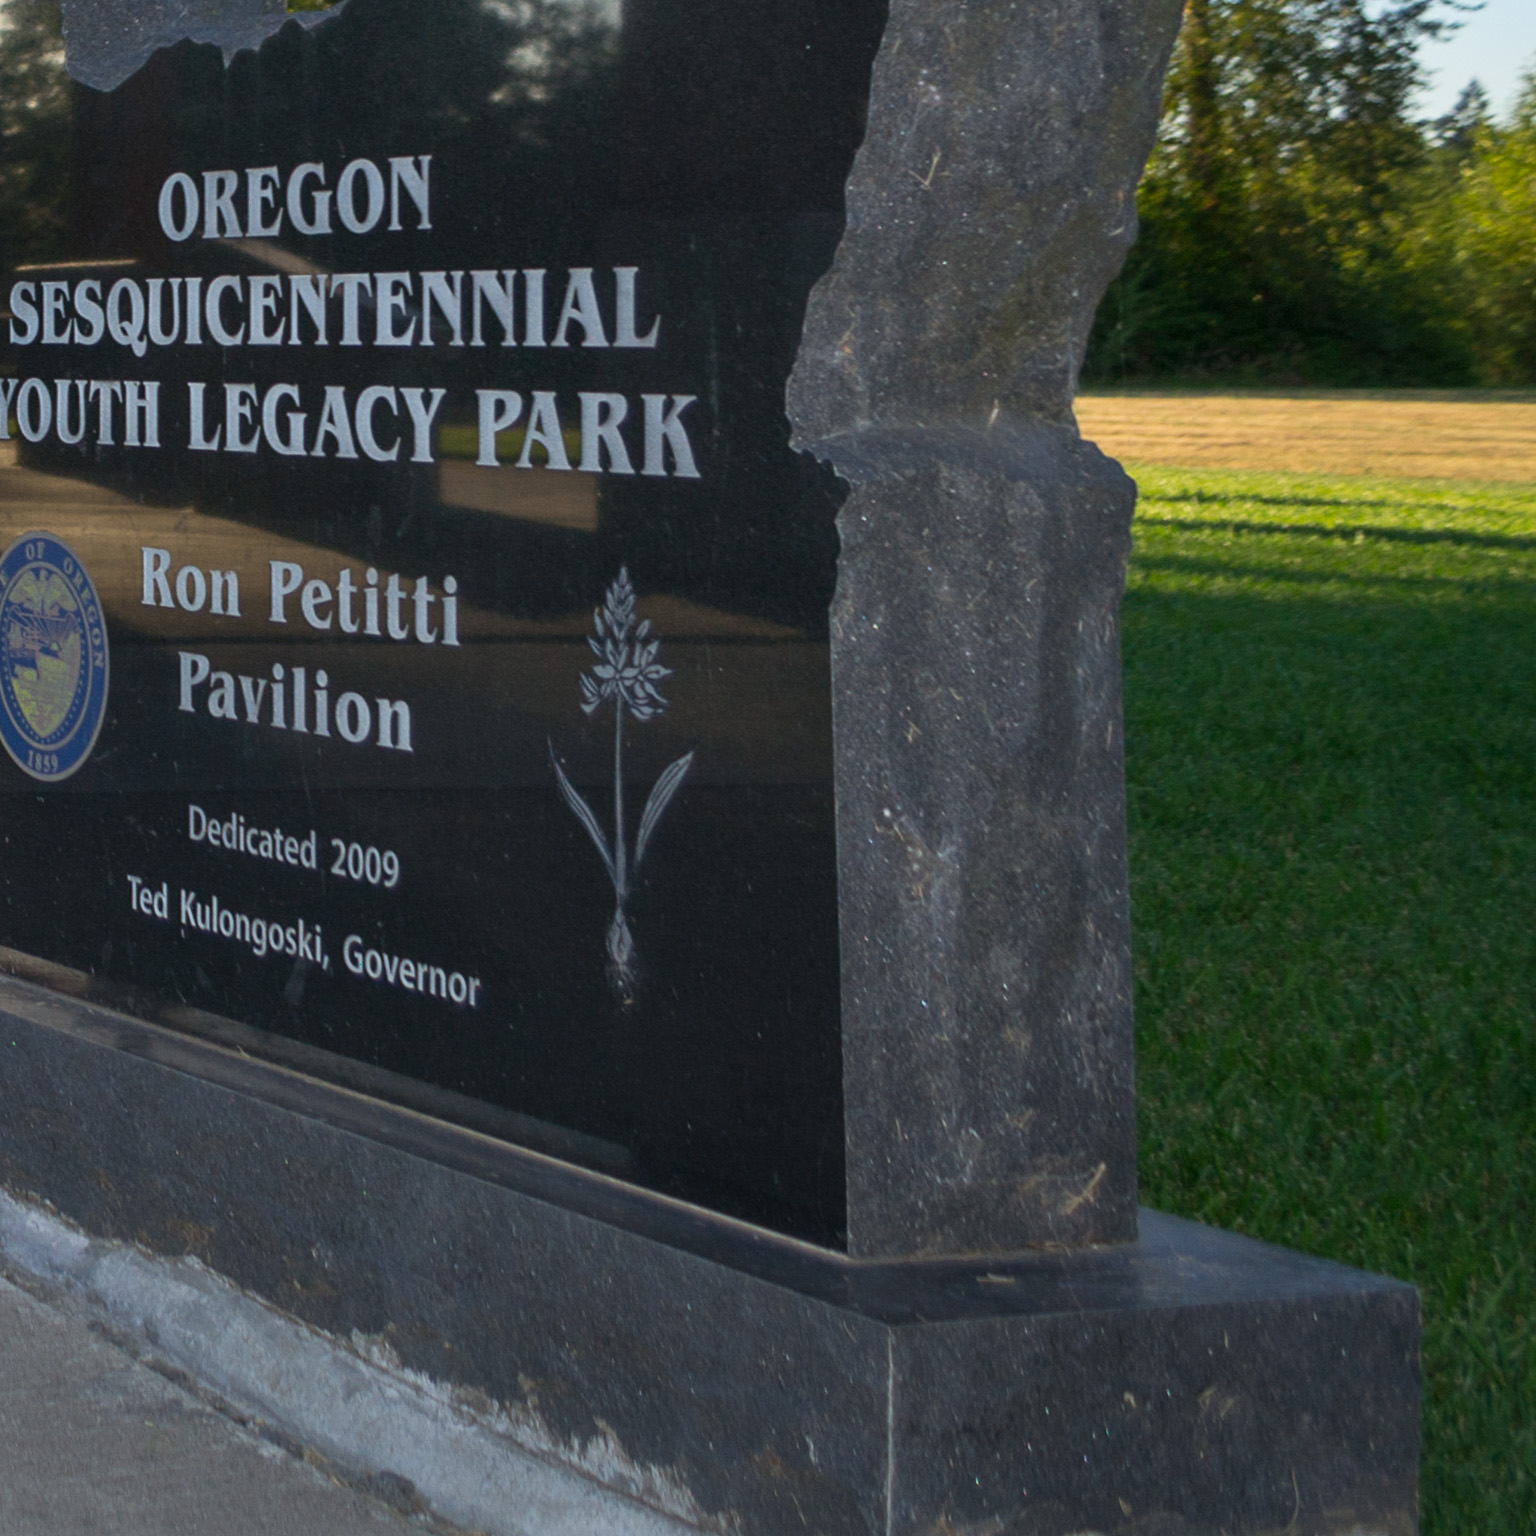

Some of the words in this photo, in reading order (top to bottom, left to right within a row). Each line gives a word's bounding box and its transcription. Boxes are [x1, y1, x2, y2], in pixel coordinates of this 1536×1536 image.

[158, 154, 433, 242] OREGON
[9, 267, 661, 358] SESQUICENTENNIAL
[187, 382, 447, 464] LEGACY
[475, 389, 702, 478] PARK
[24, 541, 46, 562] OF
[62, 555, 106, 669] OREGON
[141, 546, 242, 618] Ron
[269, 560, 462, 647] Petitti
[178, 651, 415, 752] Pavilion
[26, 748, 59, 774] 1859
[188, 804, 317, 870] Dedicated
[330, 837, 400, 888] 2009
[127, 874, 169, 920] Ted
[179, 888, 330, 971] Kulongoski,
[342, 934, 481, 1008] Governor
